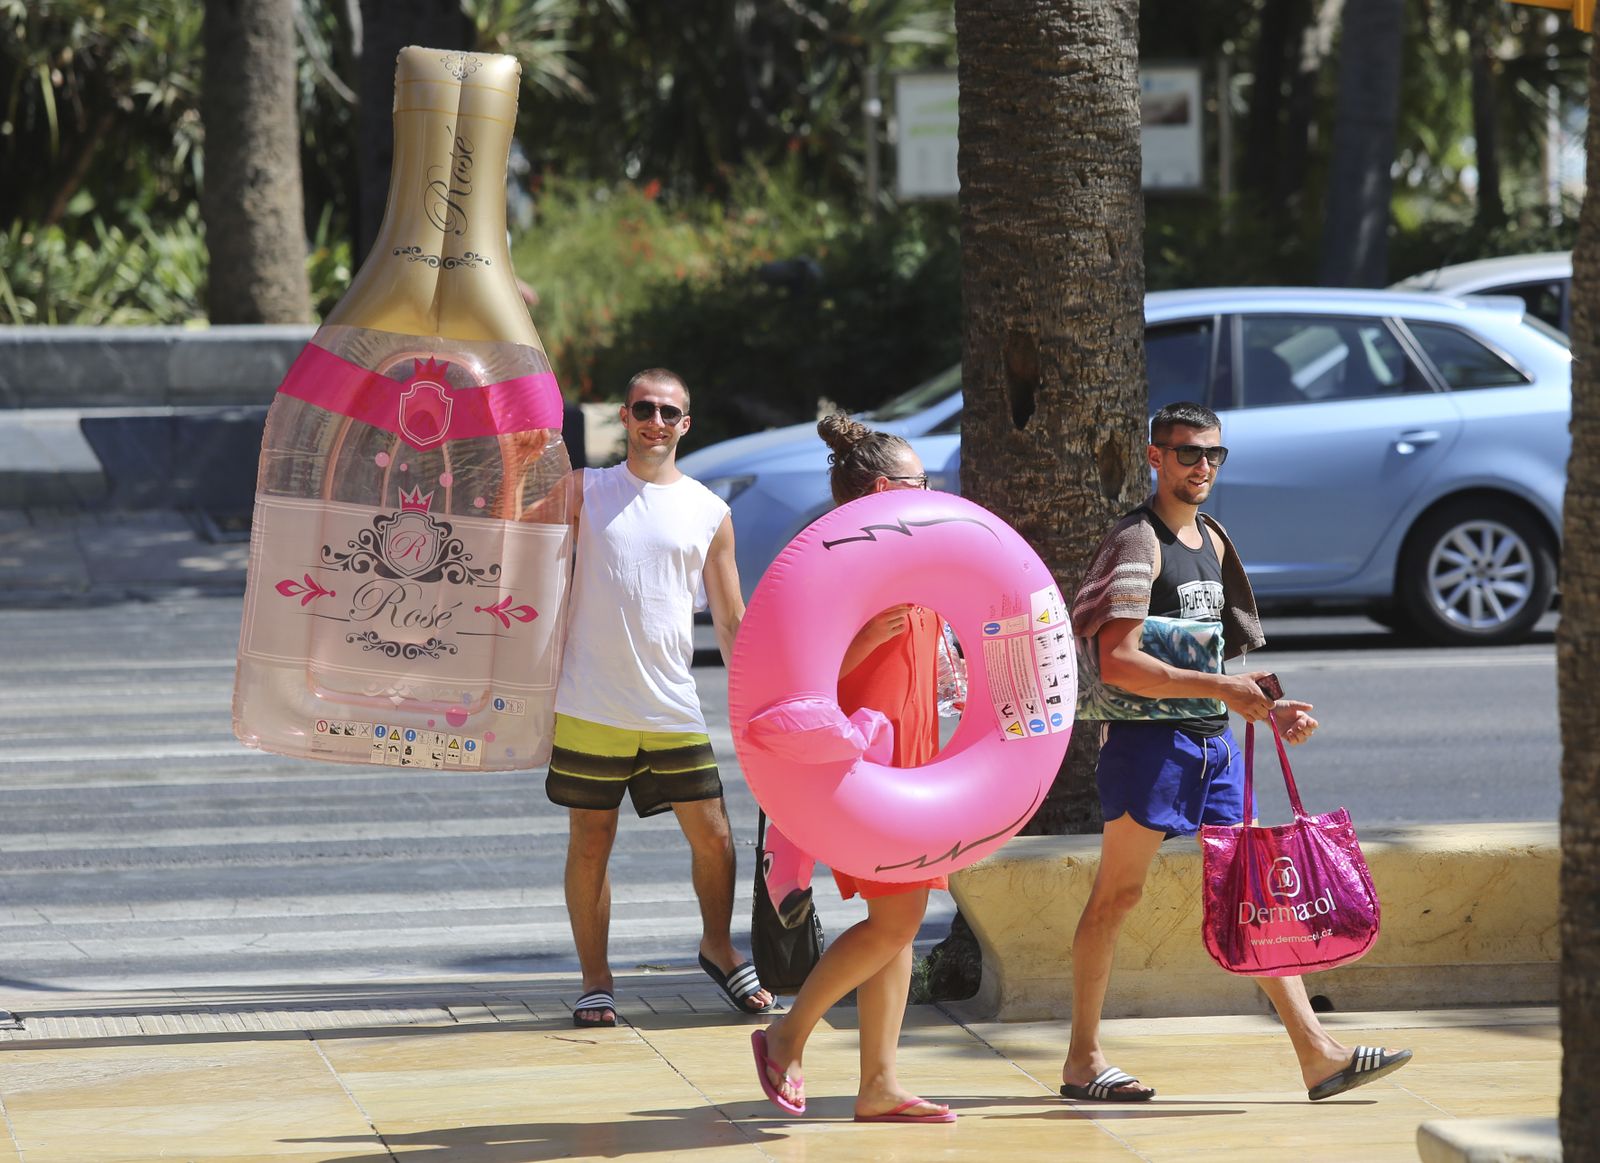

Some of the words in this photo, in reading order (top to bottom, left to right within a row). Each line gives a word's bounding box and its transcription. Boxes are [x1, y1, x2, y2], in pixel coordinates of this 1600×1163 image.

[389, 530, 427, 561] R
[348, 579, 463, 629] Rosé
[1238, 887, 1337, 924] Dermacol
[1250, 928, 1333, 946] www.dermacol.cz
